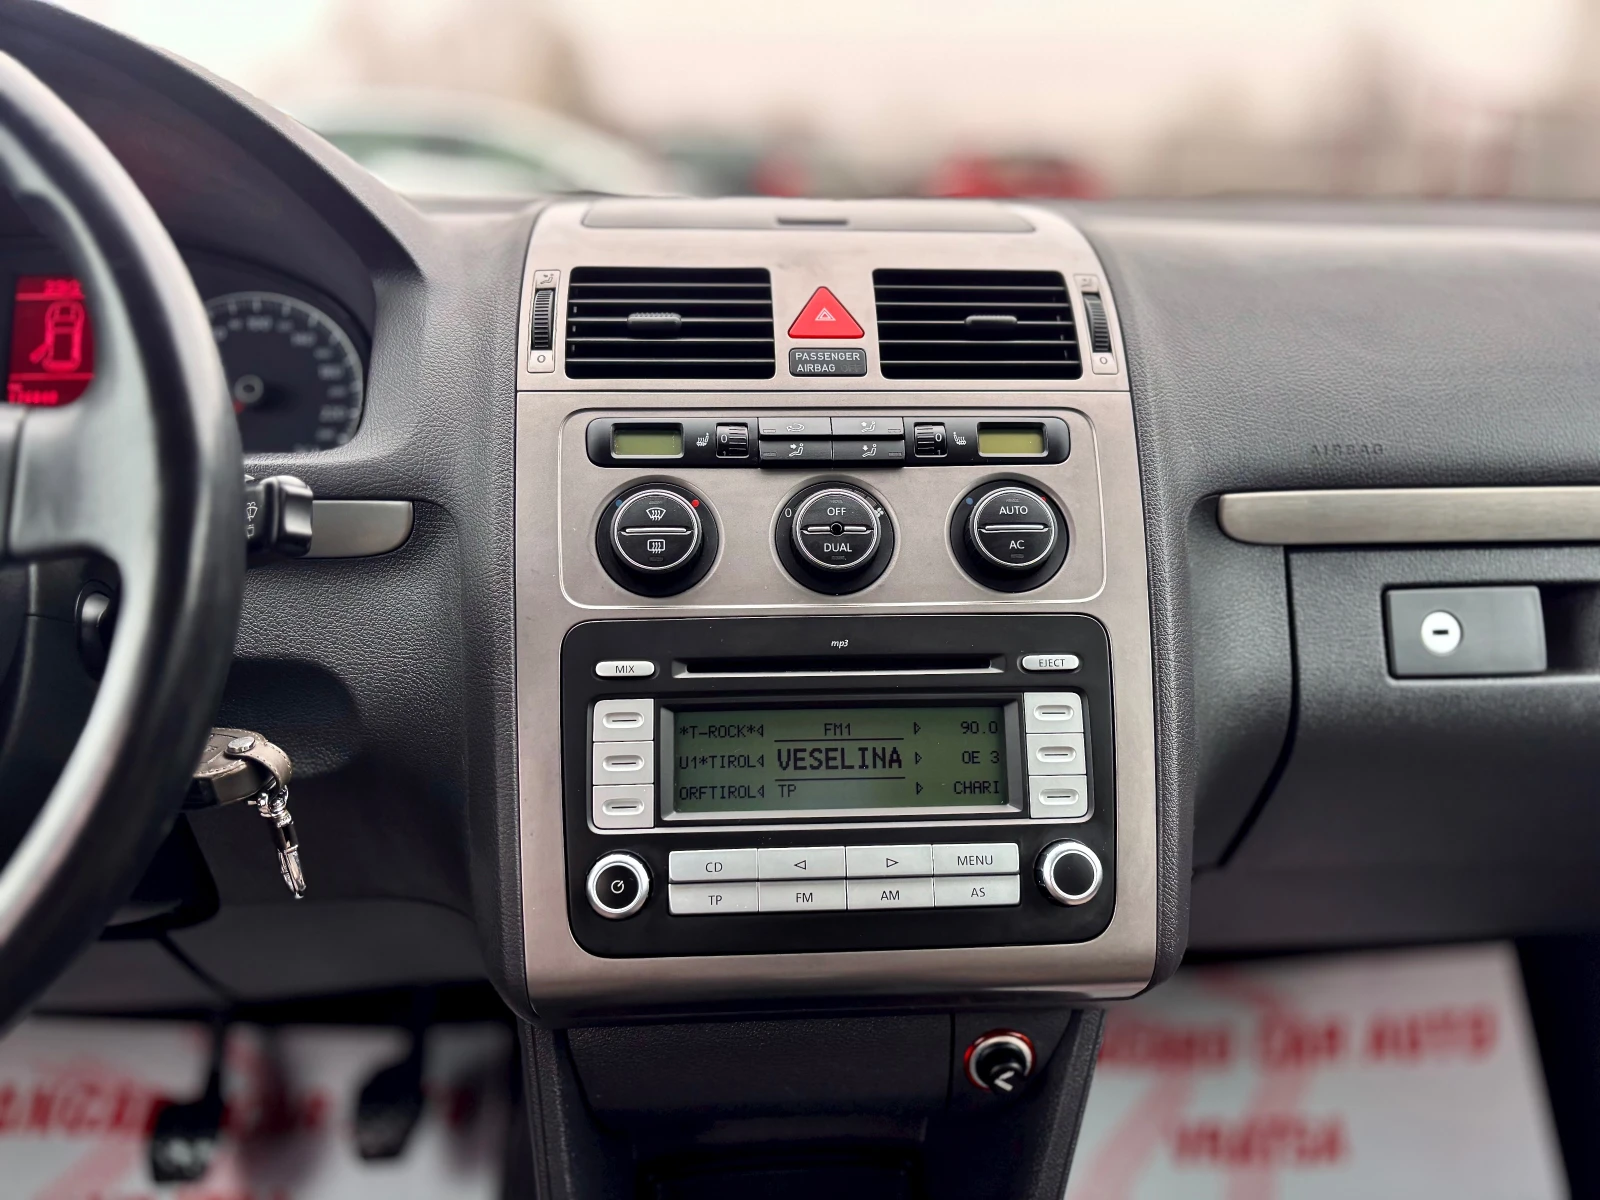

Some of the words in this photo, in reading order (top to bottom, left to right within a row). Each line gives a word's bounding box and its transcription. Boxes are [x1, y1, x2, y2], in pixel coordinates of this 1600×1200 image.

[795, 352, 861, 361] PASSENGER
[796, 363, 836, 373] AIRBAG
[1310, 443, 1384, 456] AIRBAG
[827, 507, 847, 516] OFF
[999, 505, 1029, 515] AUTO
[823, 542, 853, 552] DUAL
[1009, 540, 1025, 550] AC
[830, 639, 849, 650] mp3
[1038, 658, 1066, 668] EJECT
[615, 664, 635, 674] MIX
[823, 722, 851, 737] FM1
[960, 720, 998, 735] 90.0
[776, 746, 903, 771] VESELINA
[990, 750, 1000, 764] 3
[679, 785, 757, 800] ORFTIROL
[777, 783, 797, 798] TP
[953, 780, 1000, 795] CHARI
[956, 855, 994, 866] MENU
[704, 861, 723, 873] CD
[795, 892, 814, 903] FM
[880, 890, 901, 901] AM
[970, 887, 986, 898] AS
[708, 894, 723, 906] TP
